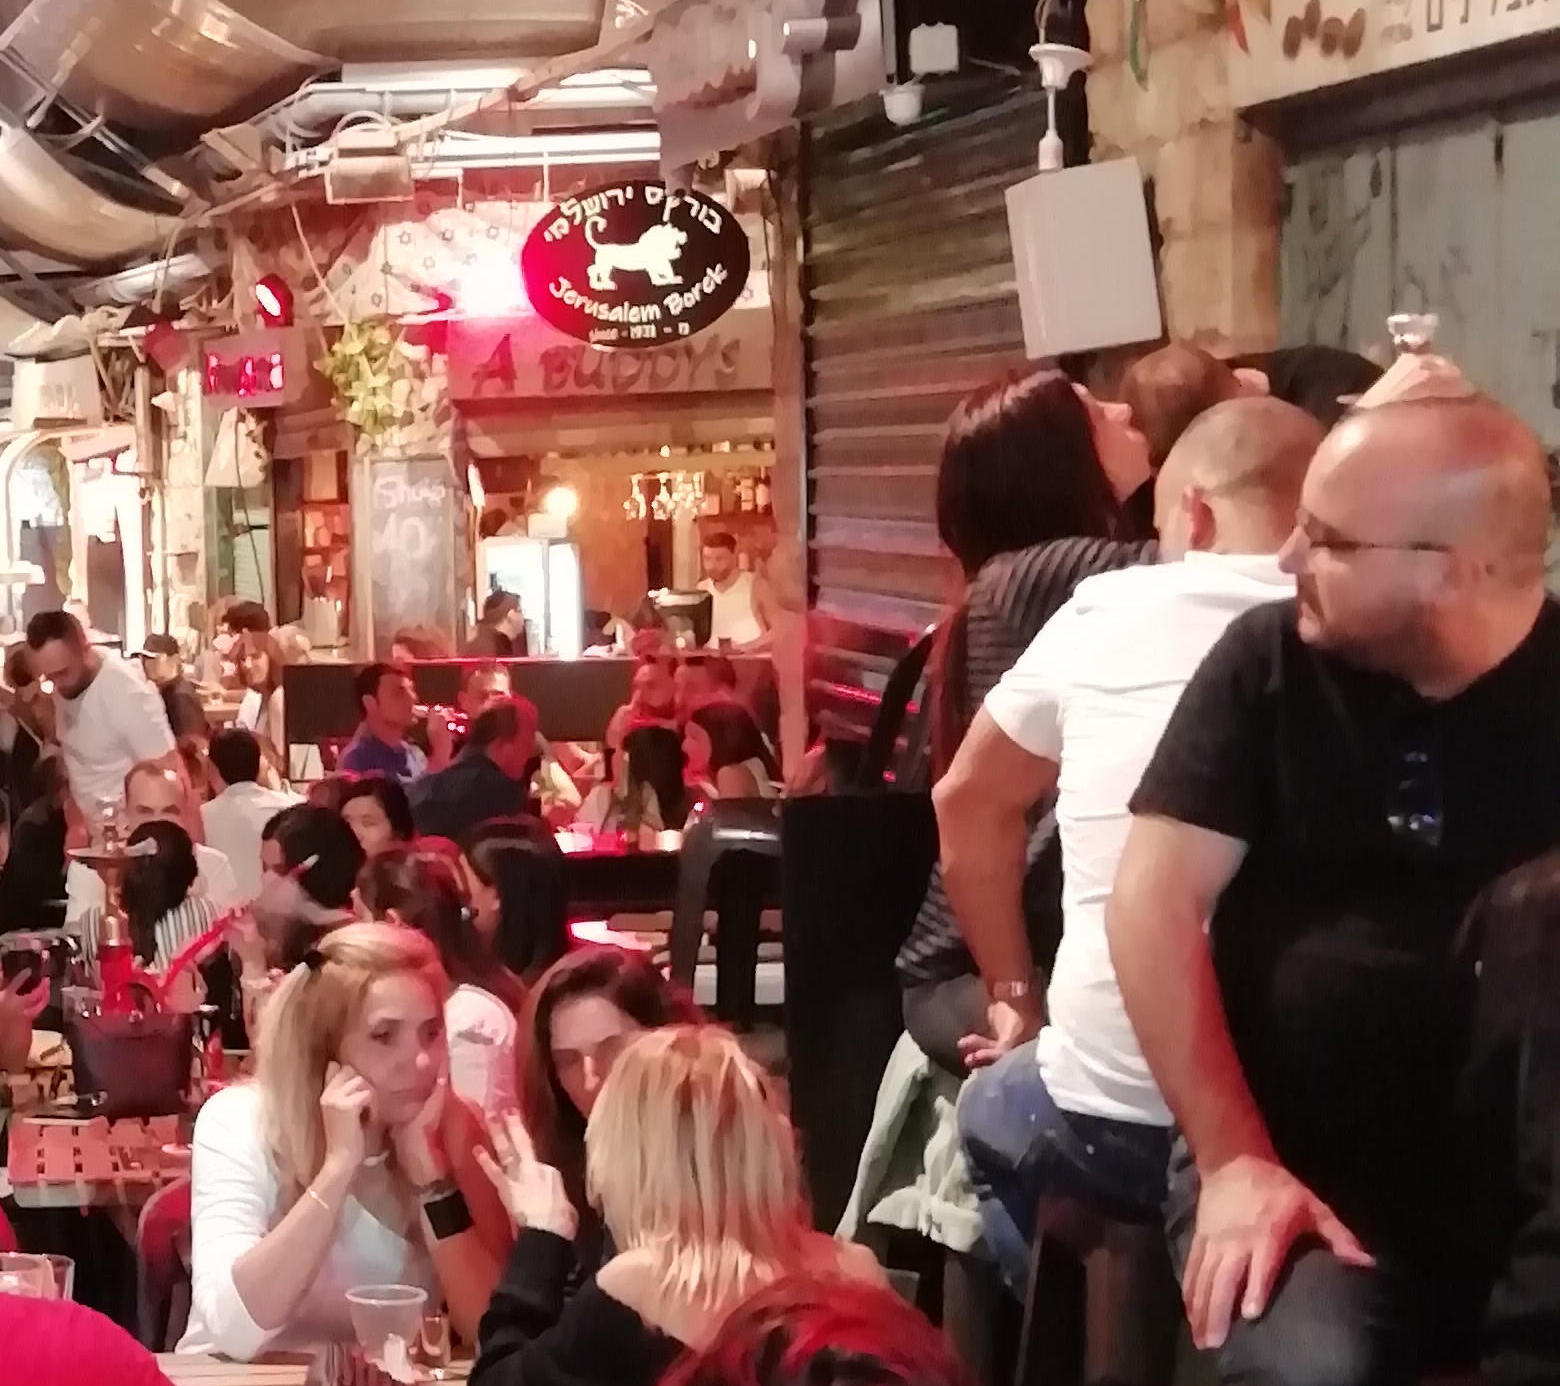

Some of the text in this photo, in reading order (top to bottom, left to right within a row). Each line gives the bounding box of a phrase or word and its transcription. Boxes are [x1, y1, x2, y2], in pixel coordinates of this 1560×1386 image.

[543, 186, 634, 243] ירושלמי
[548, 263, 729, 323] Jerusalem Borek
